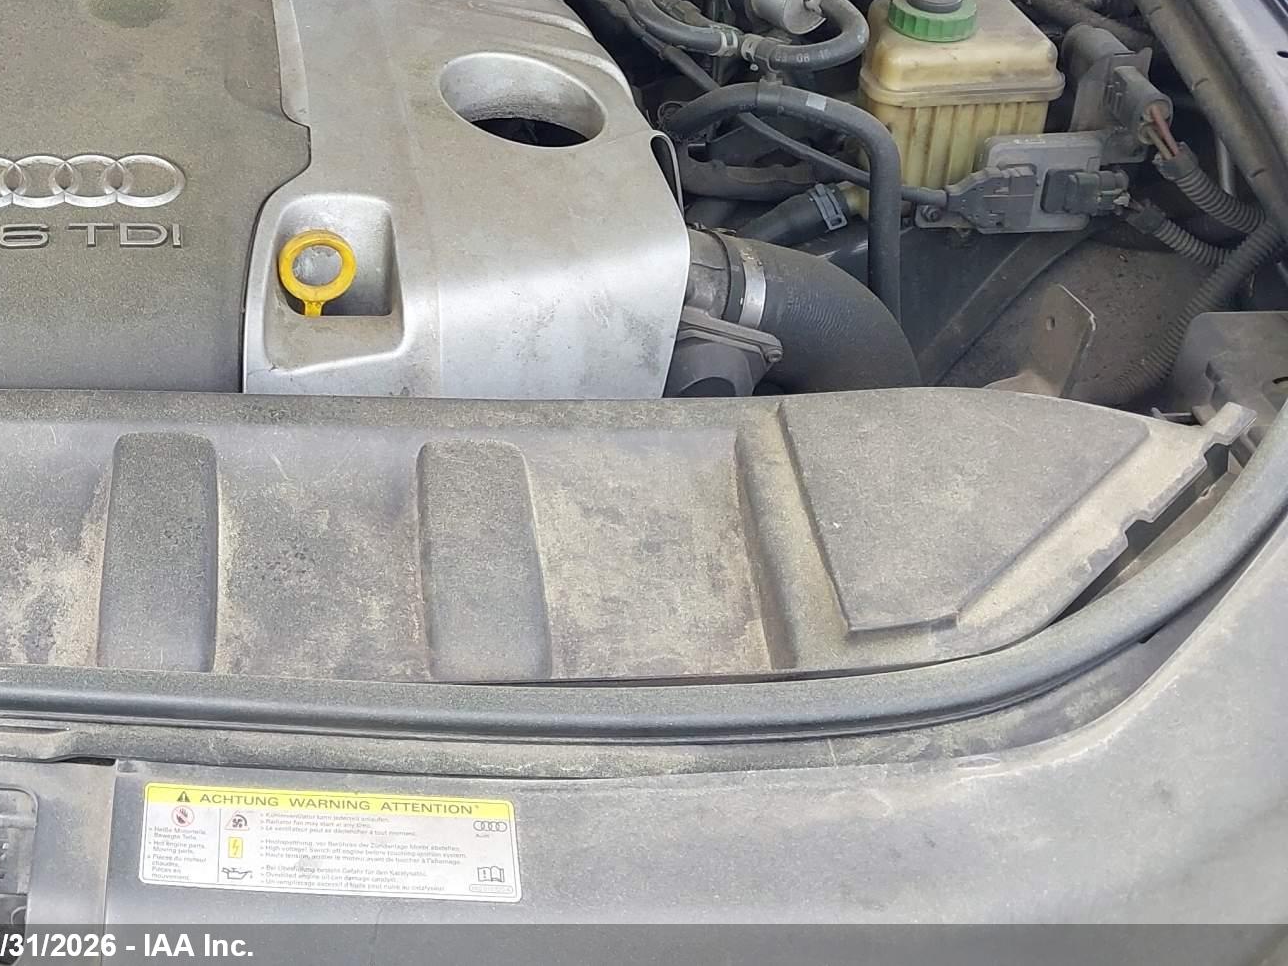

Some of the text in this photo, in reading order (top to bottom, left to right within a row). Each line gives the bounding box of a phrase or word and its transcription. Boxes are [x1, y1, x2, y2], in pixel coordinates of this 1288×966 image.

[68, 222, 183, 249] TDI
[199, 793, 472, 815] ACHTUNG WARNING ATTENTION
